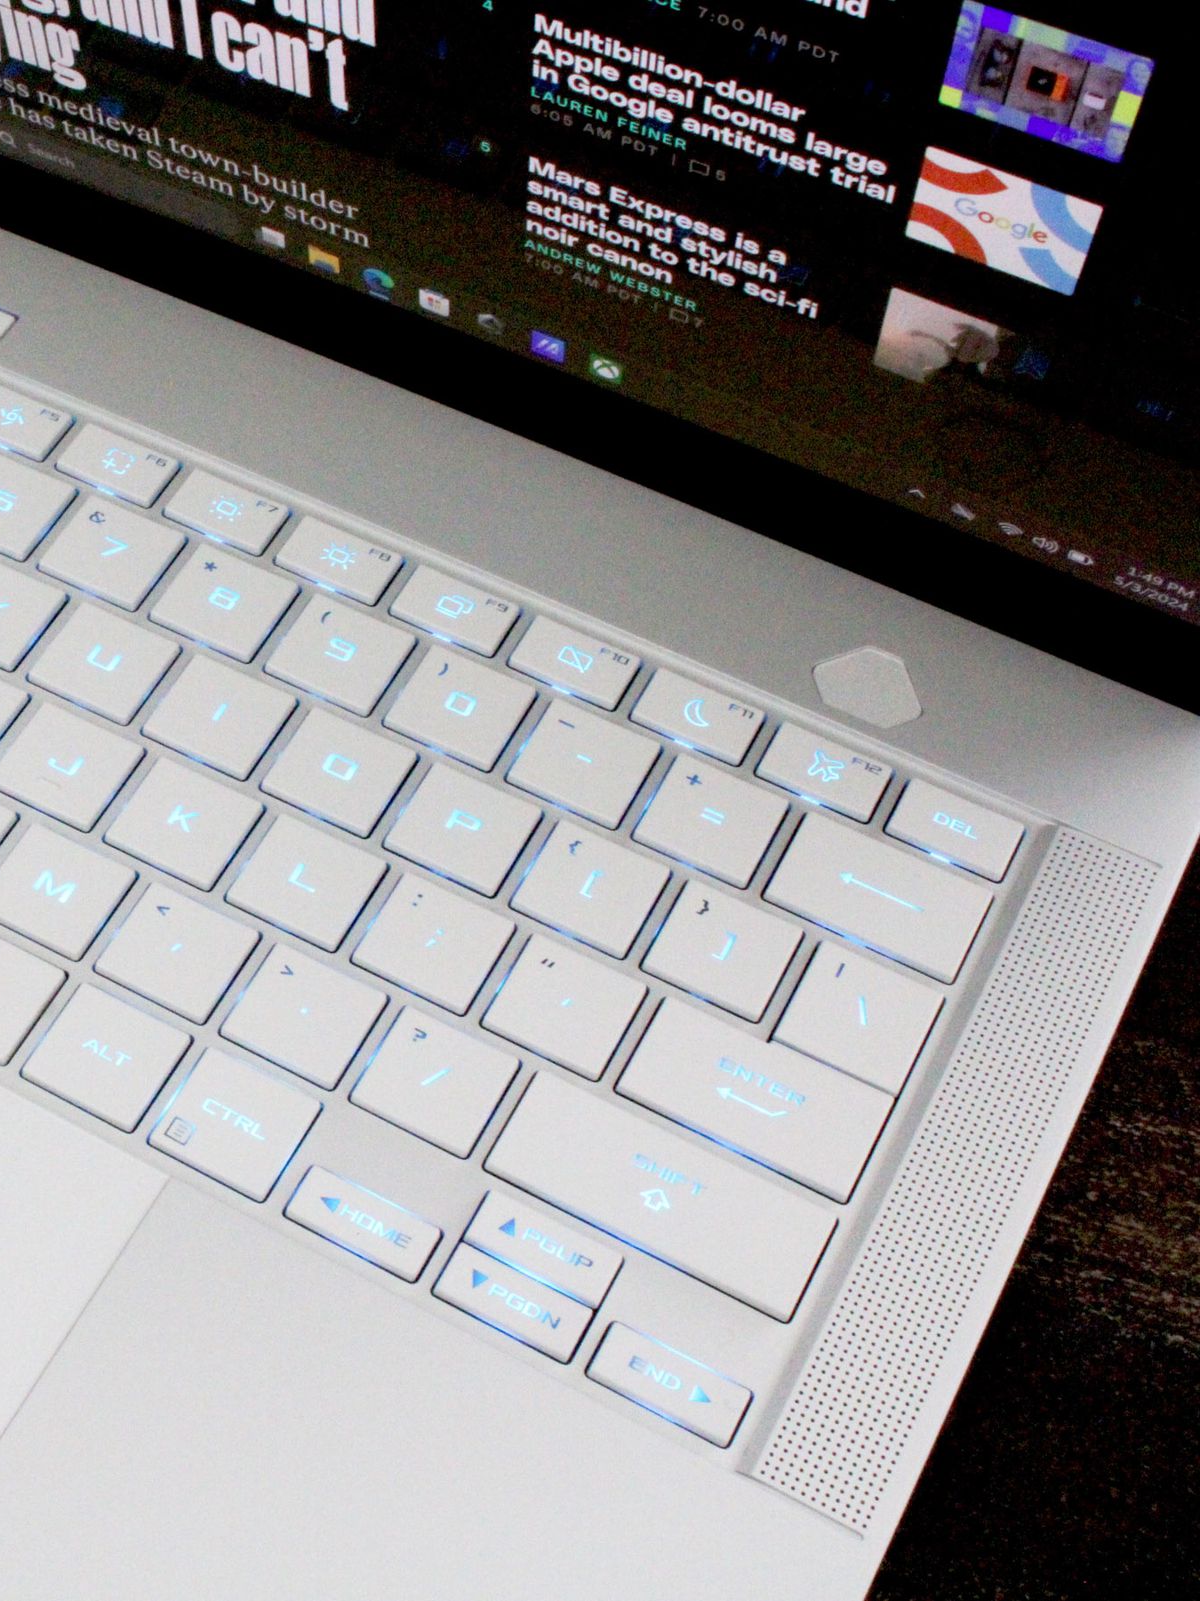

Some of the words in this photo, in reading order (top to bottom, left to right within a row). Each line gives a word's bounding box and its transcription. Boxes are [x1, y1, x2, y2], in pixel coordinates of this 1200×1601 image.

[698, 6, 745, 32] 7:00
[754, 27, 788, 46] AM
[797, 41, 840, 63] PDT
[210, 10, 350, 112] can't
[533, 13, 806, 122] Multibillion-dollar
[530, 86, 609, 123] LAUREN
[618, 117, 688, 150] FEINER
[532, 38, 621, 82] Apple
[628, 73, 695, 108] deal
[702, 96, 797, 144] looms
[804, 132, 888, 176] large
[532, 60, 559, 85] in
[566, 74, 674, 125] Google
[681, 115, 821, 178] antitrust
[830, 166, 898, 204] trial
[582, 122, 613, 141] AM
[620, 138, 659, 157] PDT
[37, 87, 161, 147] medieval
[169, 137, 360, 220] town-builder
[8, 97, 56, 130] has
[64, 121, 138, 161] taken
[147, 149, 234, 198] Steam
[243, 185, 276, 214] by
[284, 203, 370, 249] storm
[528, 156, 601, 197] Mars
[609, 186, 726, 243] Express
[735, 232, 761, 256] is
[767, 250, 788, 267] a
[954, 196, 1049, 244] Google
[526, 180, 610, 222] smart
[617, 214, 673, 245] and
[680, 235, 779, 283] stylish
[526, 219, 580, 249] noir
[587, 241, 674, 285] canon
[526, 200, 641, 252] addition
[648, 242, 680, 267] to
[687, 255, 736, 288] the
[744, 281, 820, 320] sci-fi
[524, 239, 602, 275] ANDREW
[608, 270, 698, 313] WEBSTER
[40, 409, 60, 422] F5
[146, 453, 168, 467] F6
[89, 511, 105, 524] &
[256, 500, 279, 512] F7
[102, 536, 128, 556] 7
[369, 547, 392, 562] F8
[208, 586, 240, 610] 8
[485, 598, 510, 613] F9
[1167, 580, 1197, 599] PM
[87, 645, 122, 671] U
[325, 637, 357, 662] 9
[600, 647, 630, 665] F10
[729, 703, 755, 719] F11
[48, 757, 83, 775] J
[852, 756, 883, 775] F12
[168, 805, 199, 832] K
[445, 809, 484, 831] P
[933, 812, 977, 839] DEL
[33, 871, 75, 903] M
[289, 864, 314, 892] L
[83, 1040, 131, 1065] ALT
[717, 1056, 807, 1106] ENTER
[203, 1099, 264, 1139] CTRL
[631, 1152, 706, 1196] SHIFT
[338, 1203, 411, 1250] HOME
[521, 1226, 594, 1272] PGUP
[487, 1282, 560, 1330] PGDN
[628, 1354, 683, 1391] END
